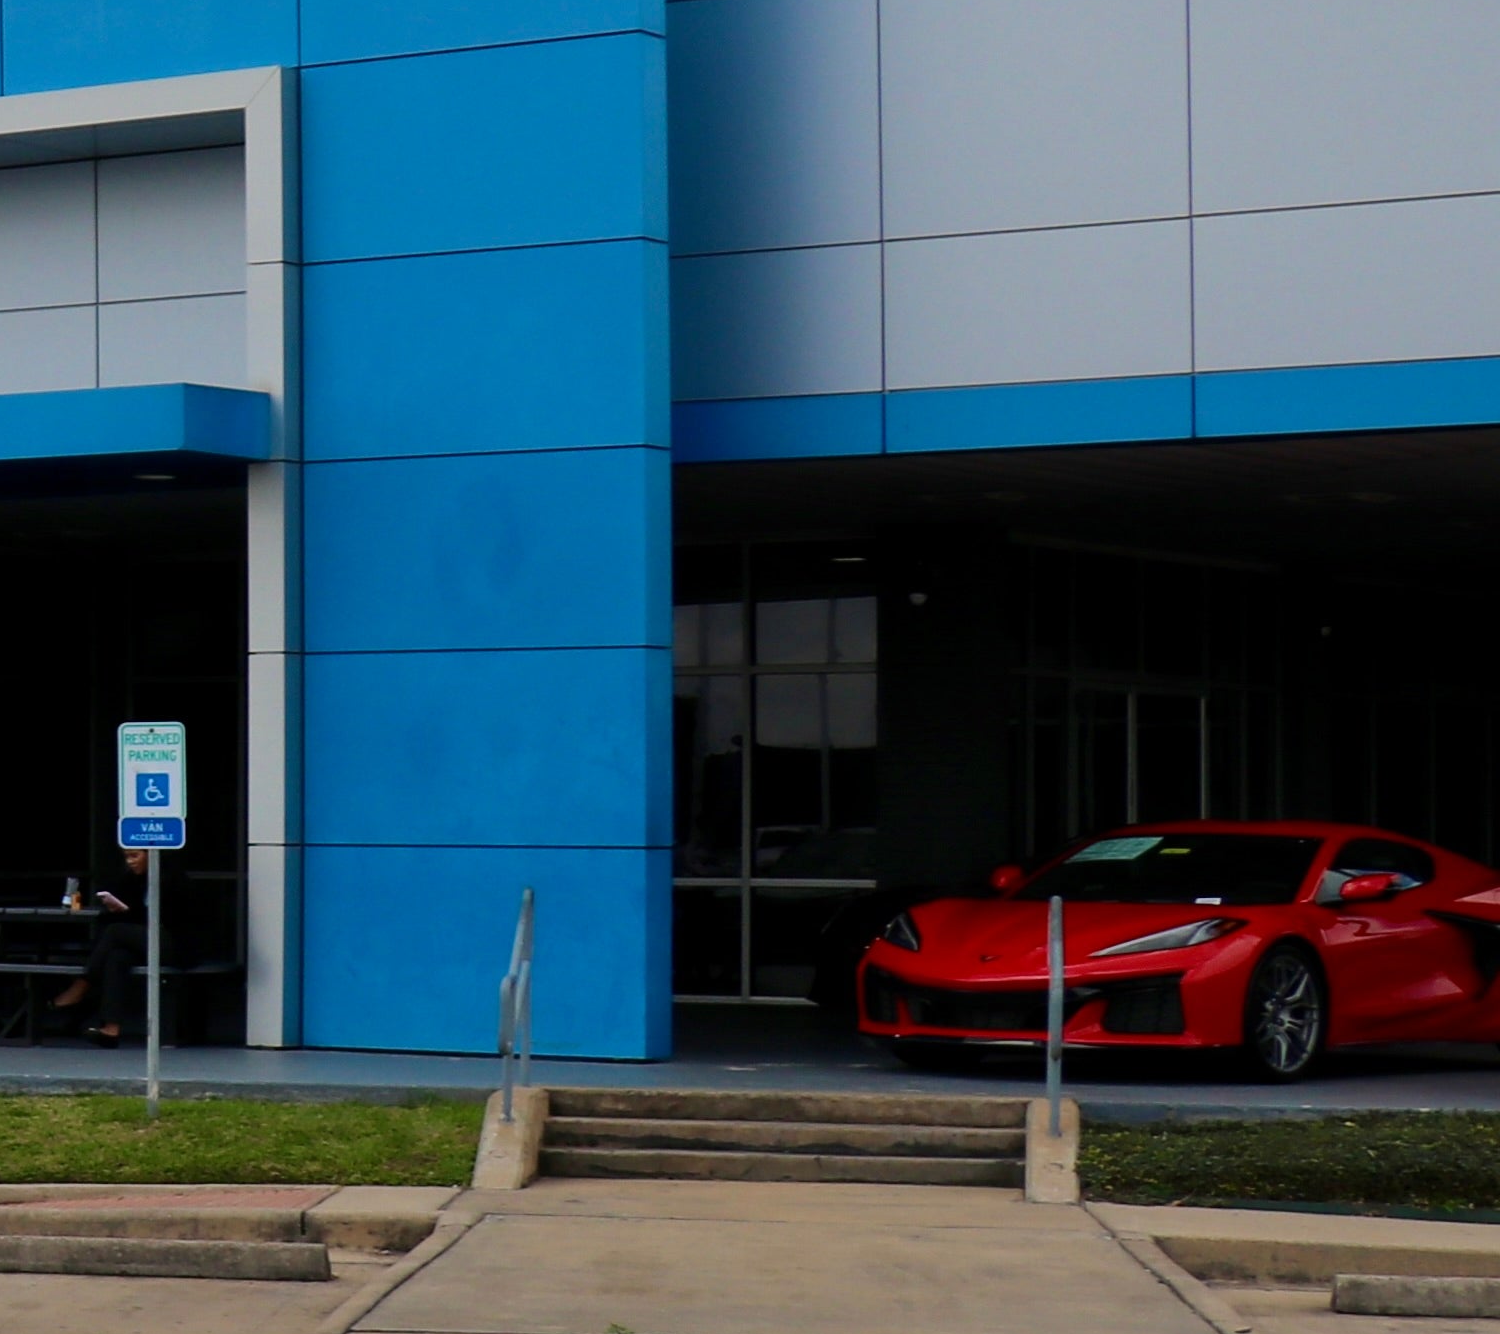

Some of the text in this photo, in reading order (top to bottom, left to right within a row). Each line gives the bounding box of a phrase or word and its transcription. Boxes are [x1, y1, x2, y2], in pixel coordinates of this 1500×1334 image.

[124, 733, 181, 745] RESERVED
[128, 750, 177, 762] PARKING
[141, 823, 163, 832] VAN
